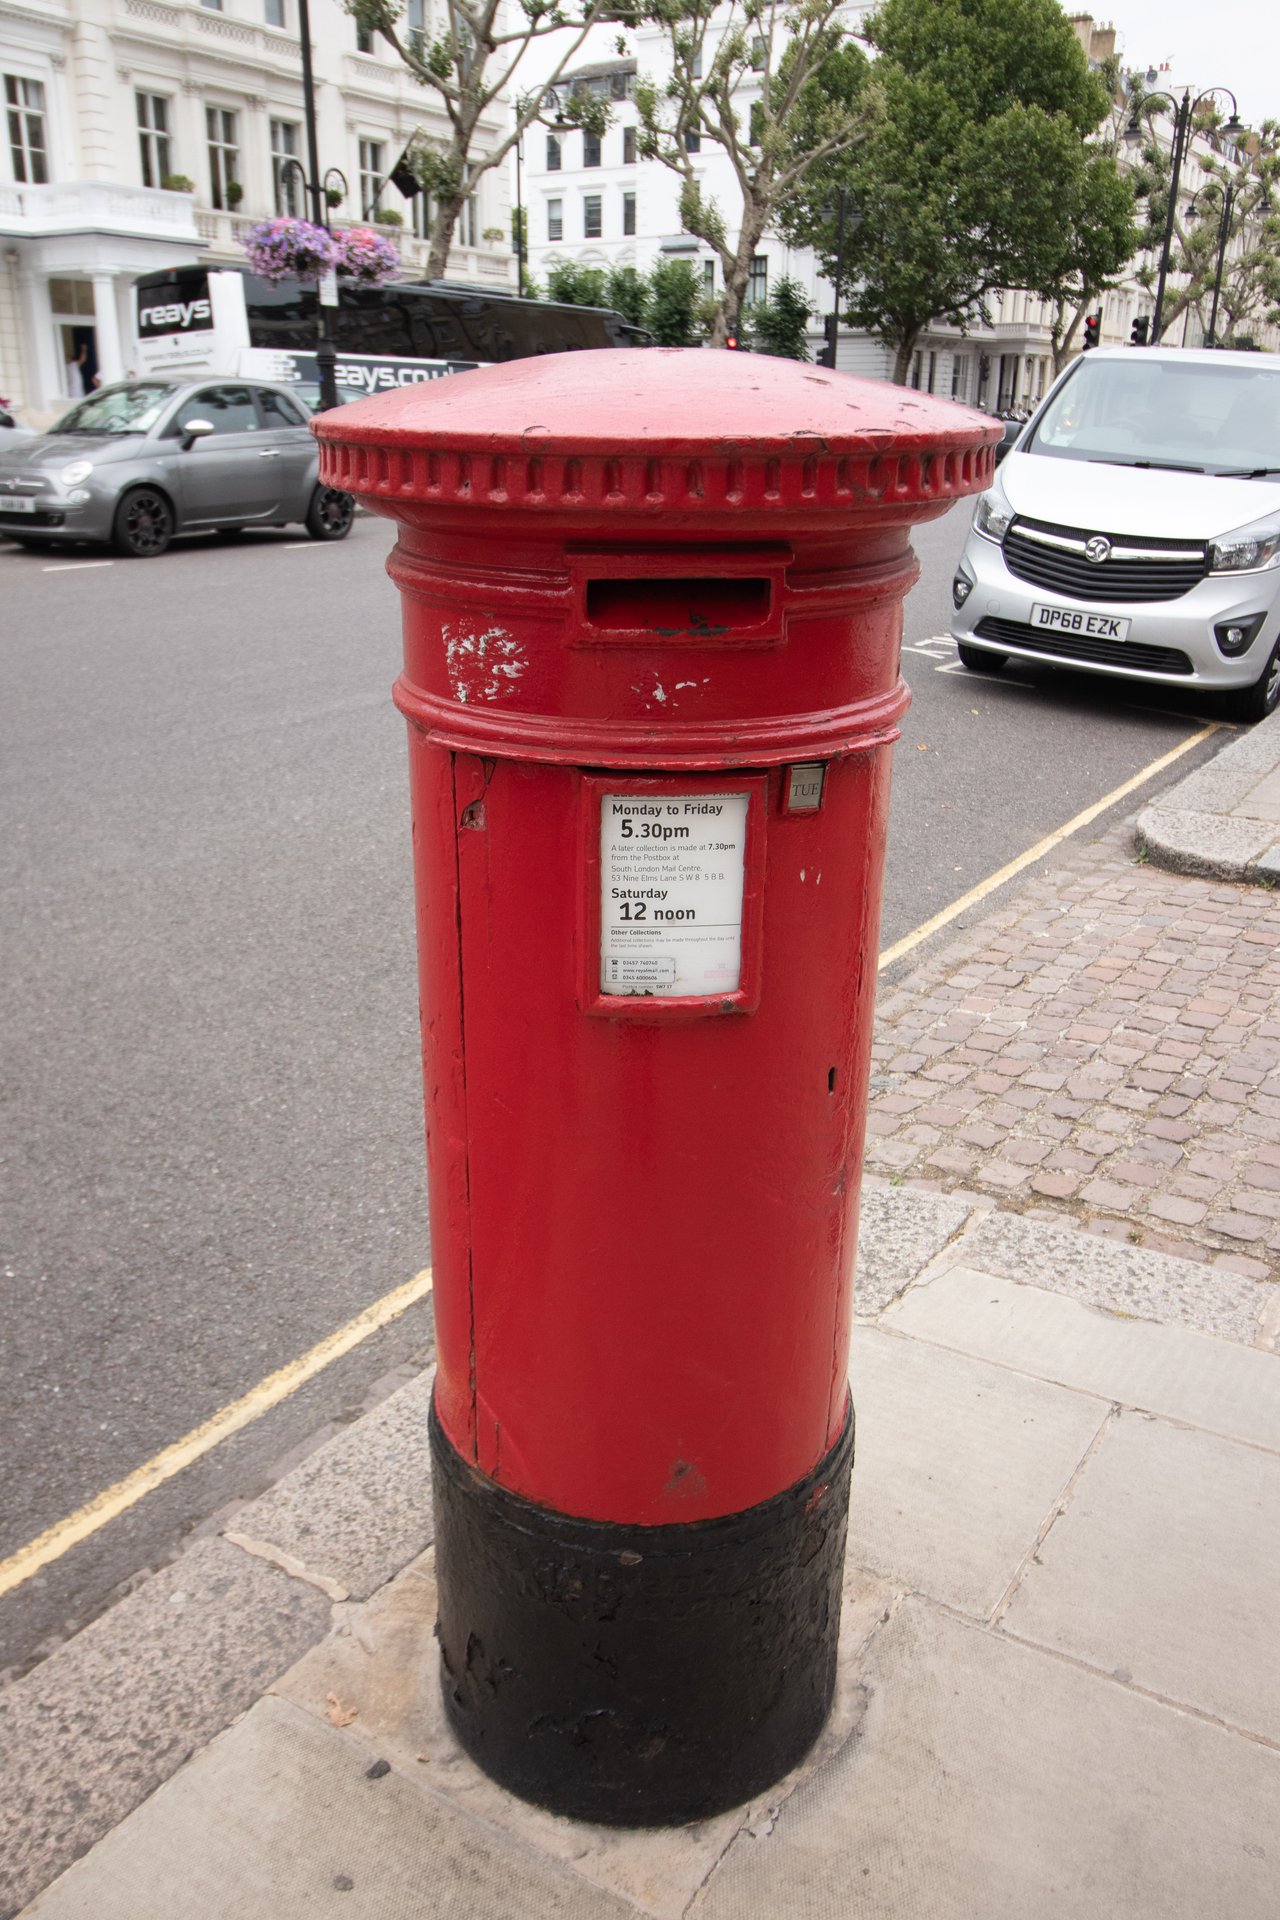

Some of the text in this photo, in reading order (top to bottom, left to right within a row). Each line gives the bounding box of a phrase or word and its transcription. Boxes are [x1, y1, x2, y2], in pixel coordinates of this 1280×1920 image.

[140, 299, 210, 327] reays
[1039, 608, 1121, 636] DP68 EZK
[792, 782, 819, 796] TUE
[612, 804, 723, 817] Monday to Friday
[621, 819, 690, 841] 5.30pm
[708, 843, 736, 851] 7.30pm
[612, 888, 668, 900] Saturday
[620, 902, 696, 920] 12 noon
